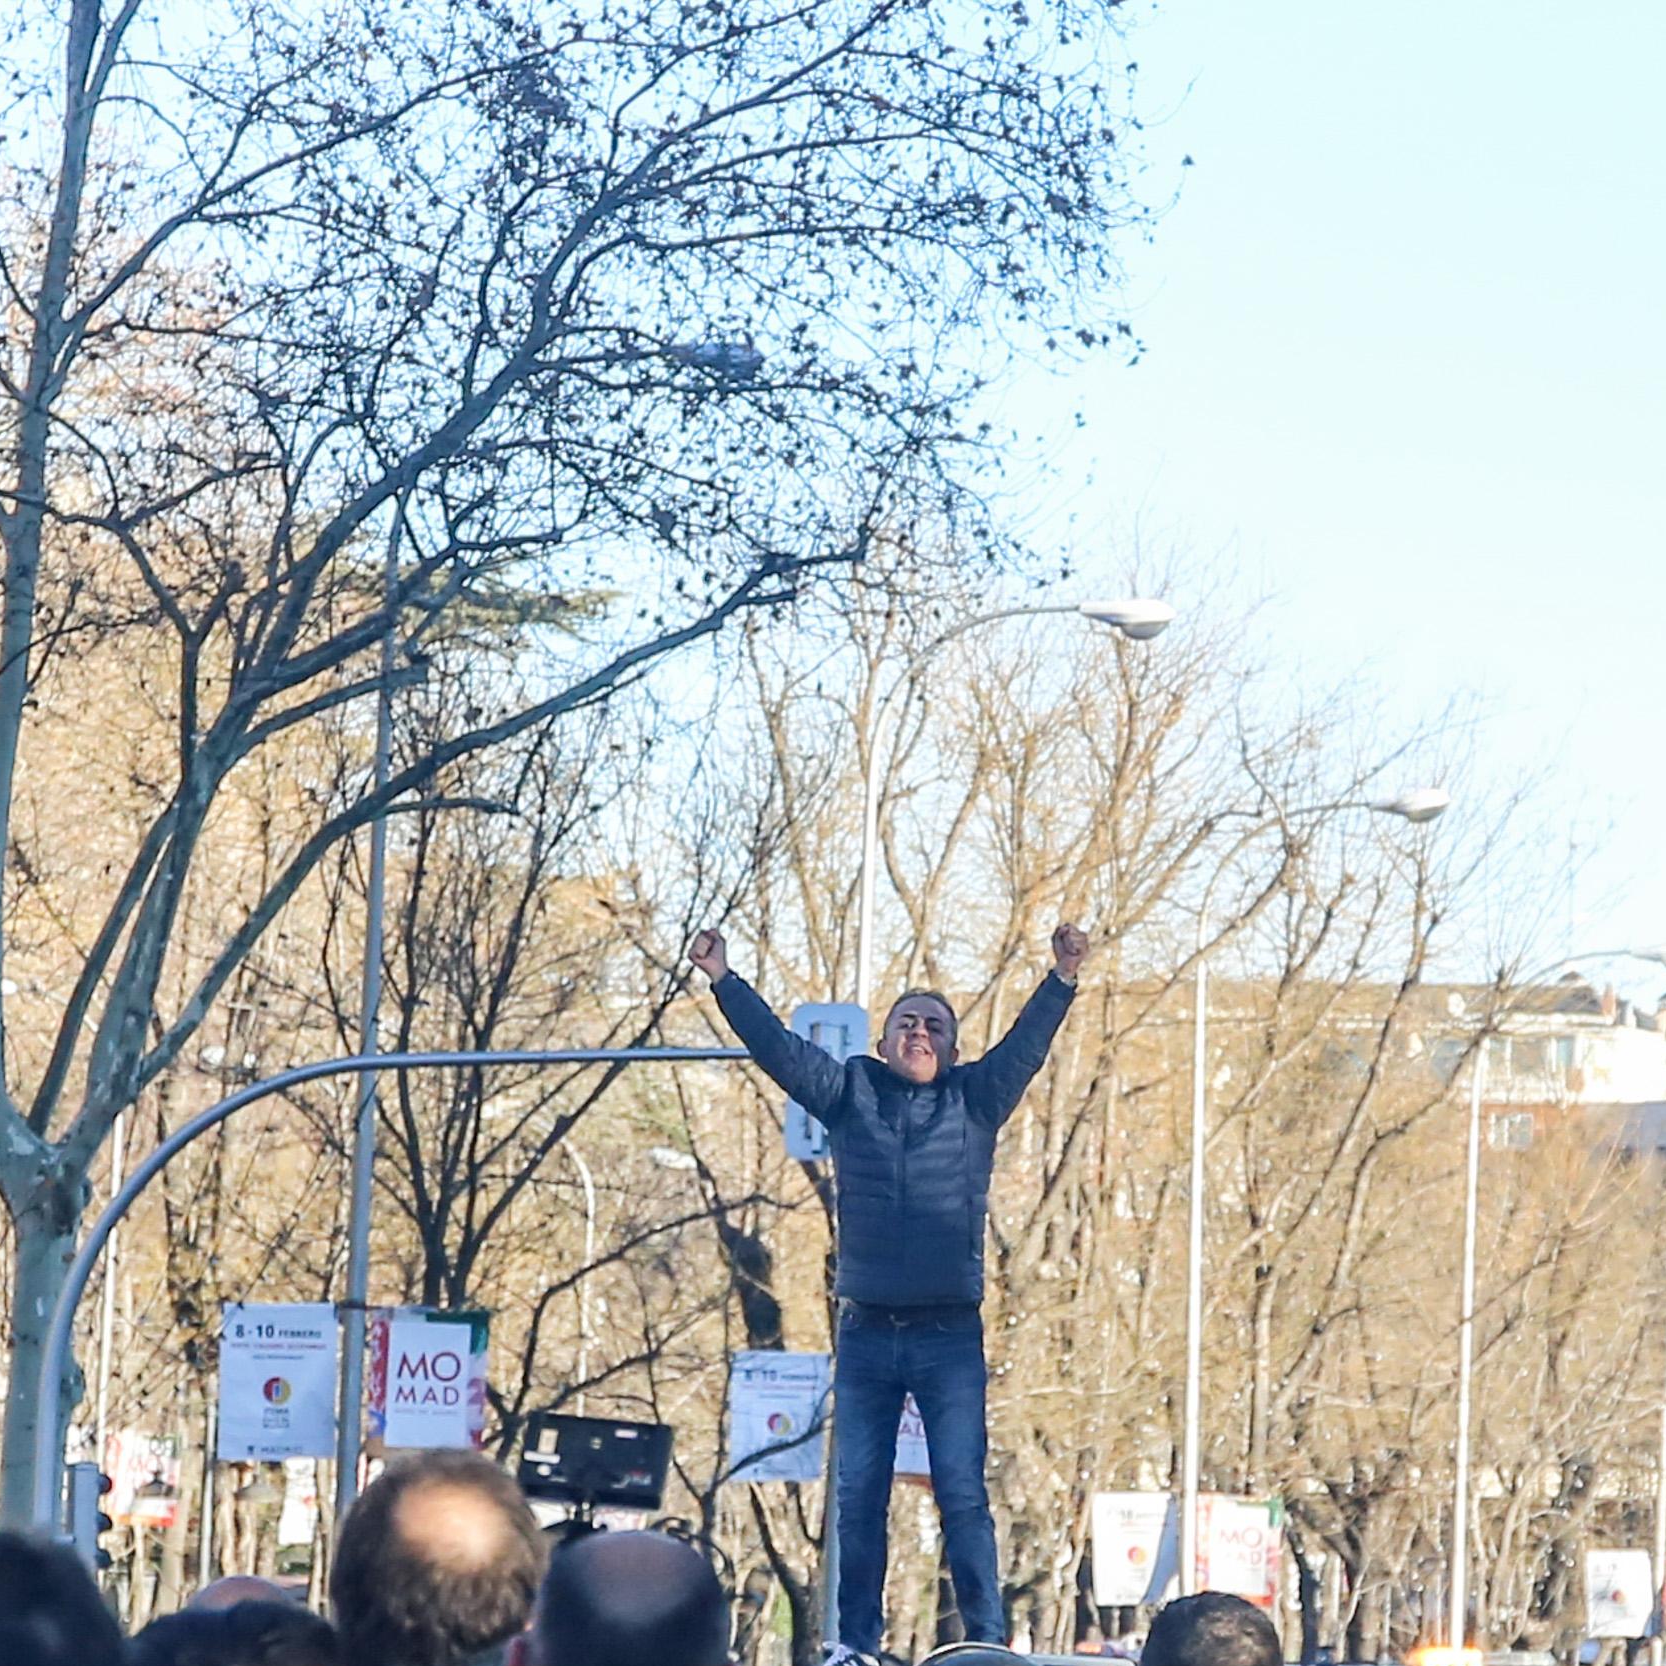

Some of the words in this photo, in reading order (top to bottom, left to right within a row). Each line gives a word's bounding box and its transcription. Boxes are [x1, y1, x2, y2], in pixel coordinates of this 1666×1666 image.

[235, 1325, 245, 1338] 8
[256, 1325, 274, 1338] 10
[397, 1352, 461, 1382] MO
[395, 1386, 460, 1406] MAD
